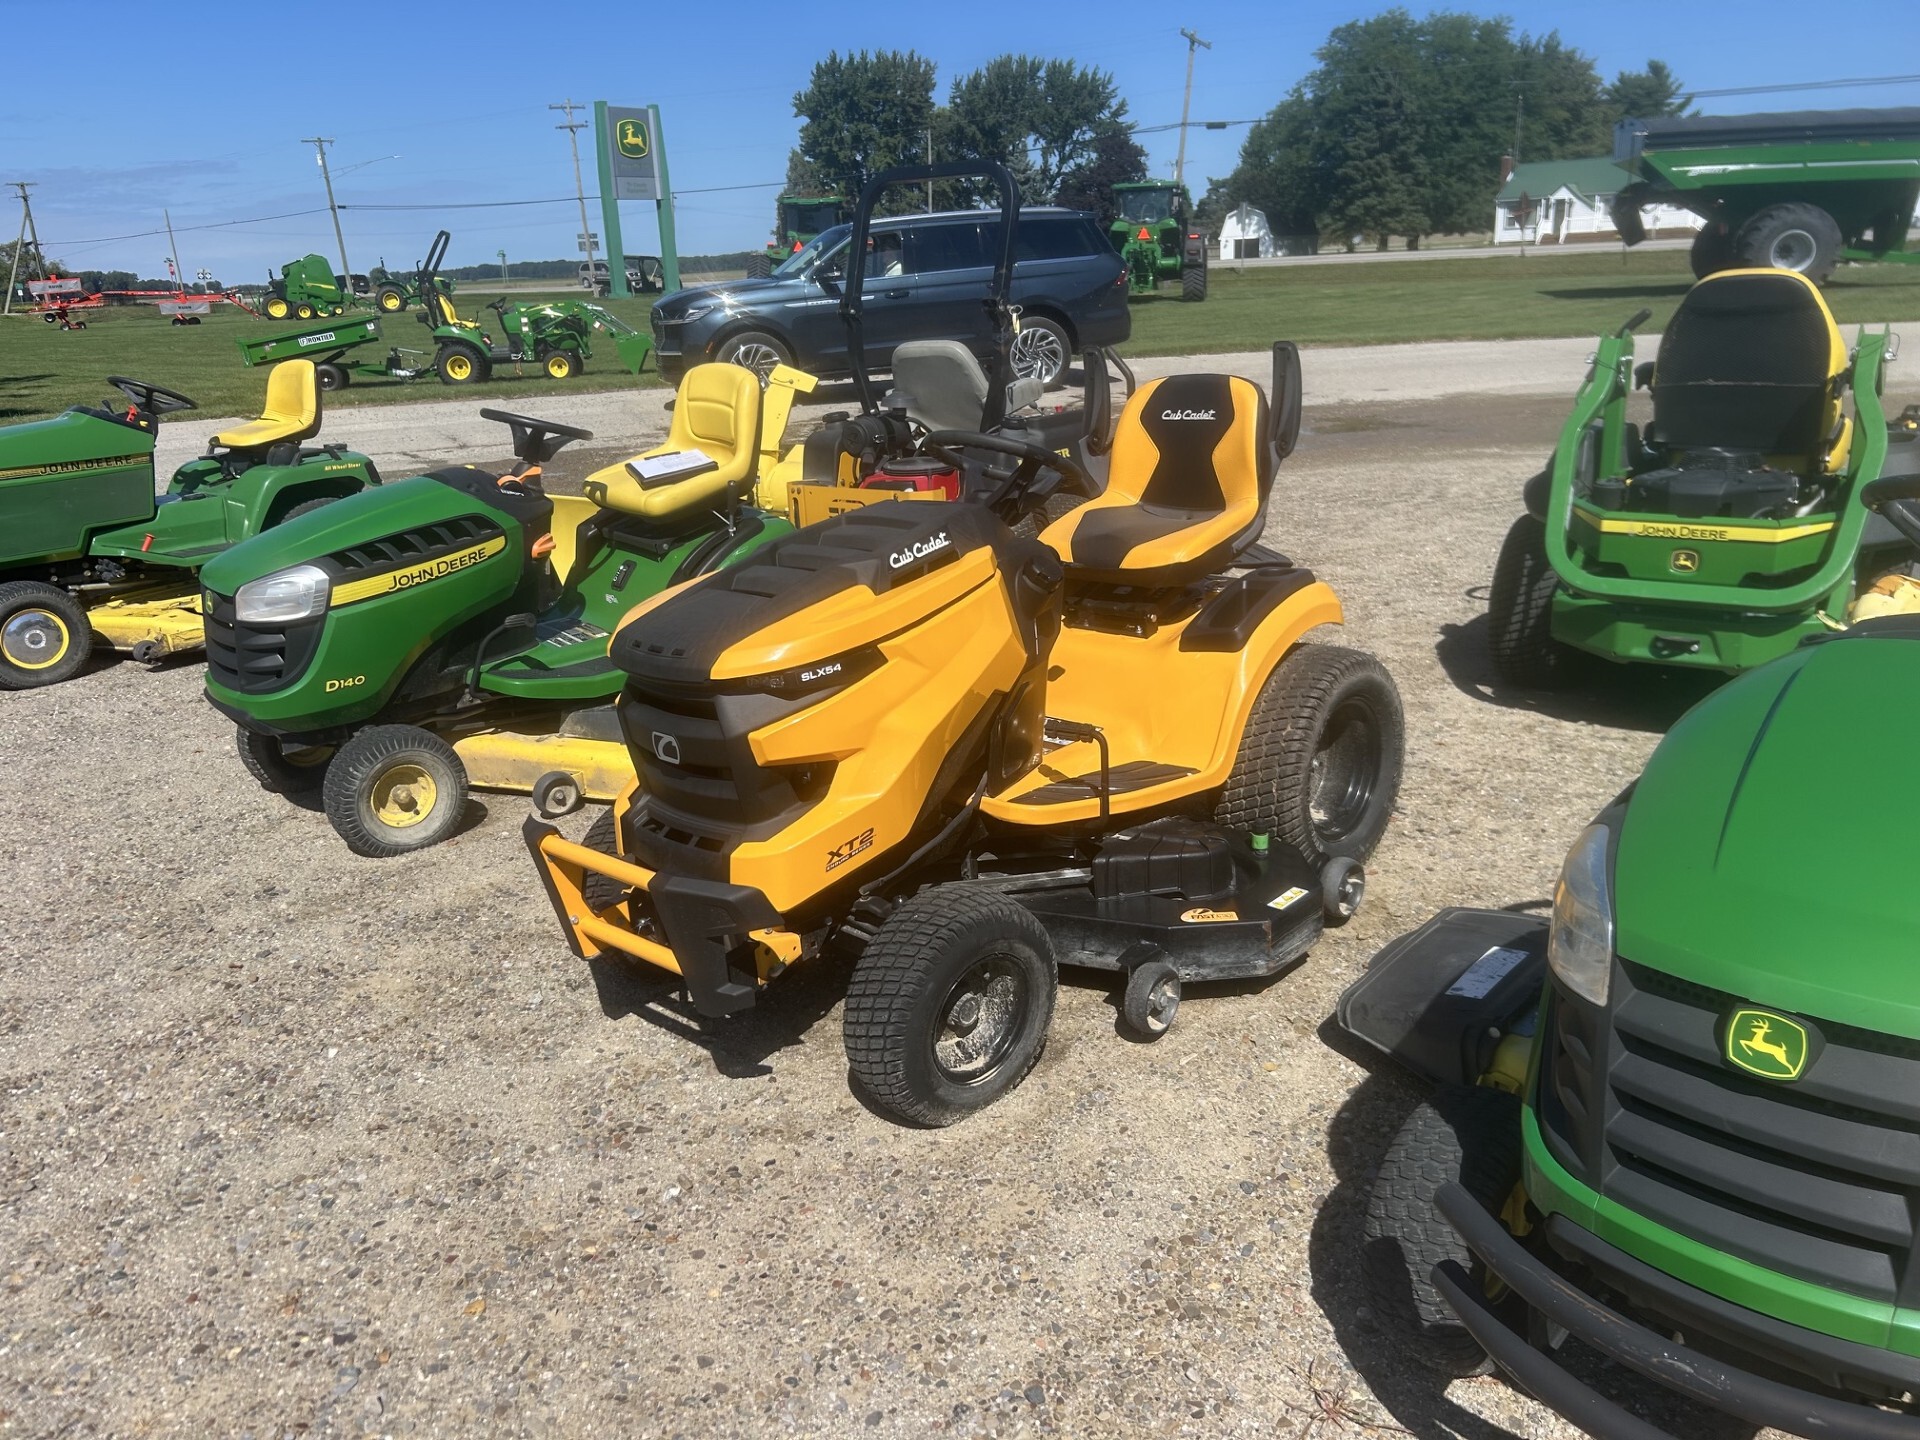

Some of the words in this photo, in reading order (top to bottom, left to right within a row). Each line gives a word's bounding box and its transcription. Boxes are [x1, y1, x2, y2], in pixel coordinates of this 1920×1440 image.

[300, 332, 335, 346] FRONTIER
[1161, 409, 1182, 420] Cub
[1182, 409, 1216, 420] Cadet
[40, 461, 81, 475] JOHN
[86, 455, 133, 469] DEERE
[1637, 524, 1677, 536] JOHN
[1680, 526, 1728, 539] DEERE
[889, 548, 914, 569] Cub
[912, 532, 951, 558] Cadet
[388, 566, 435, 591] JOHN
[436, 547, 487, 575] DEERE
[801, 663, 842, 682] SLX54
[325, 675, 366, 692] D140
[826, 827, 875, 866] XT2
